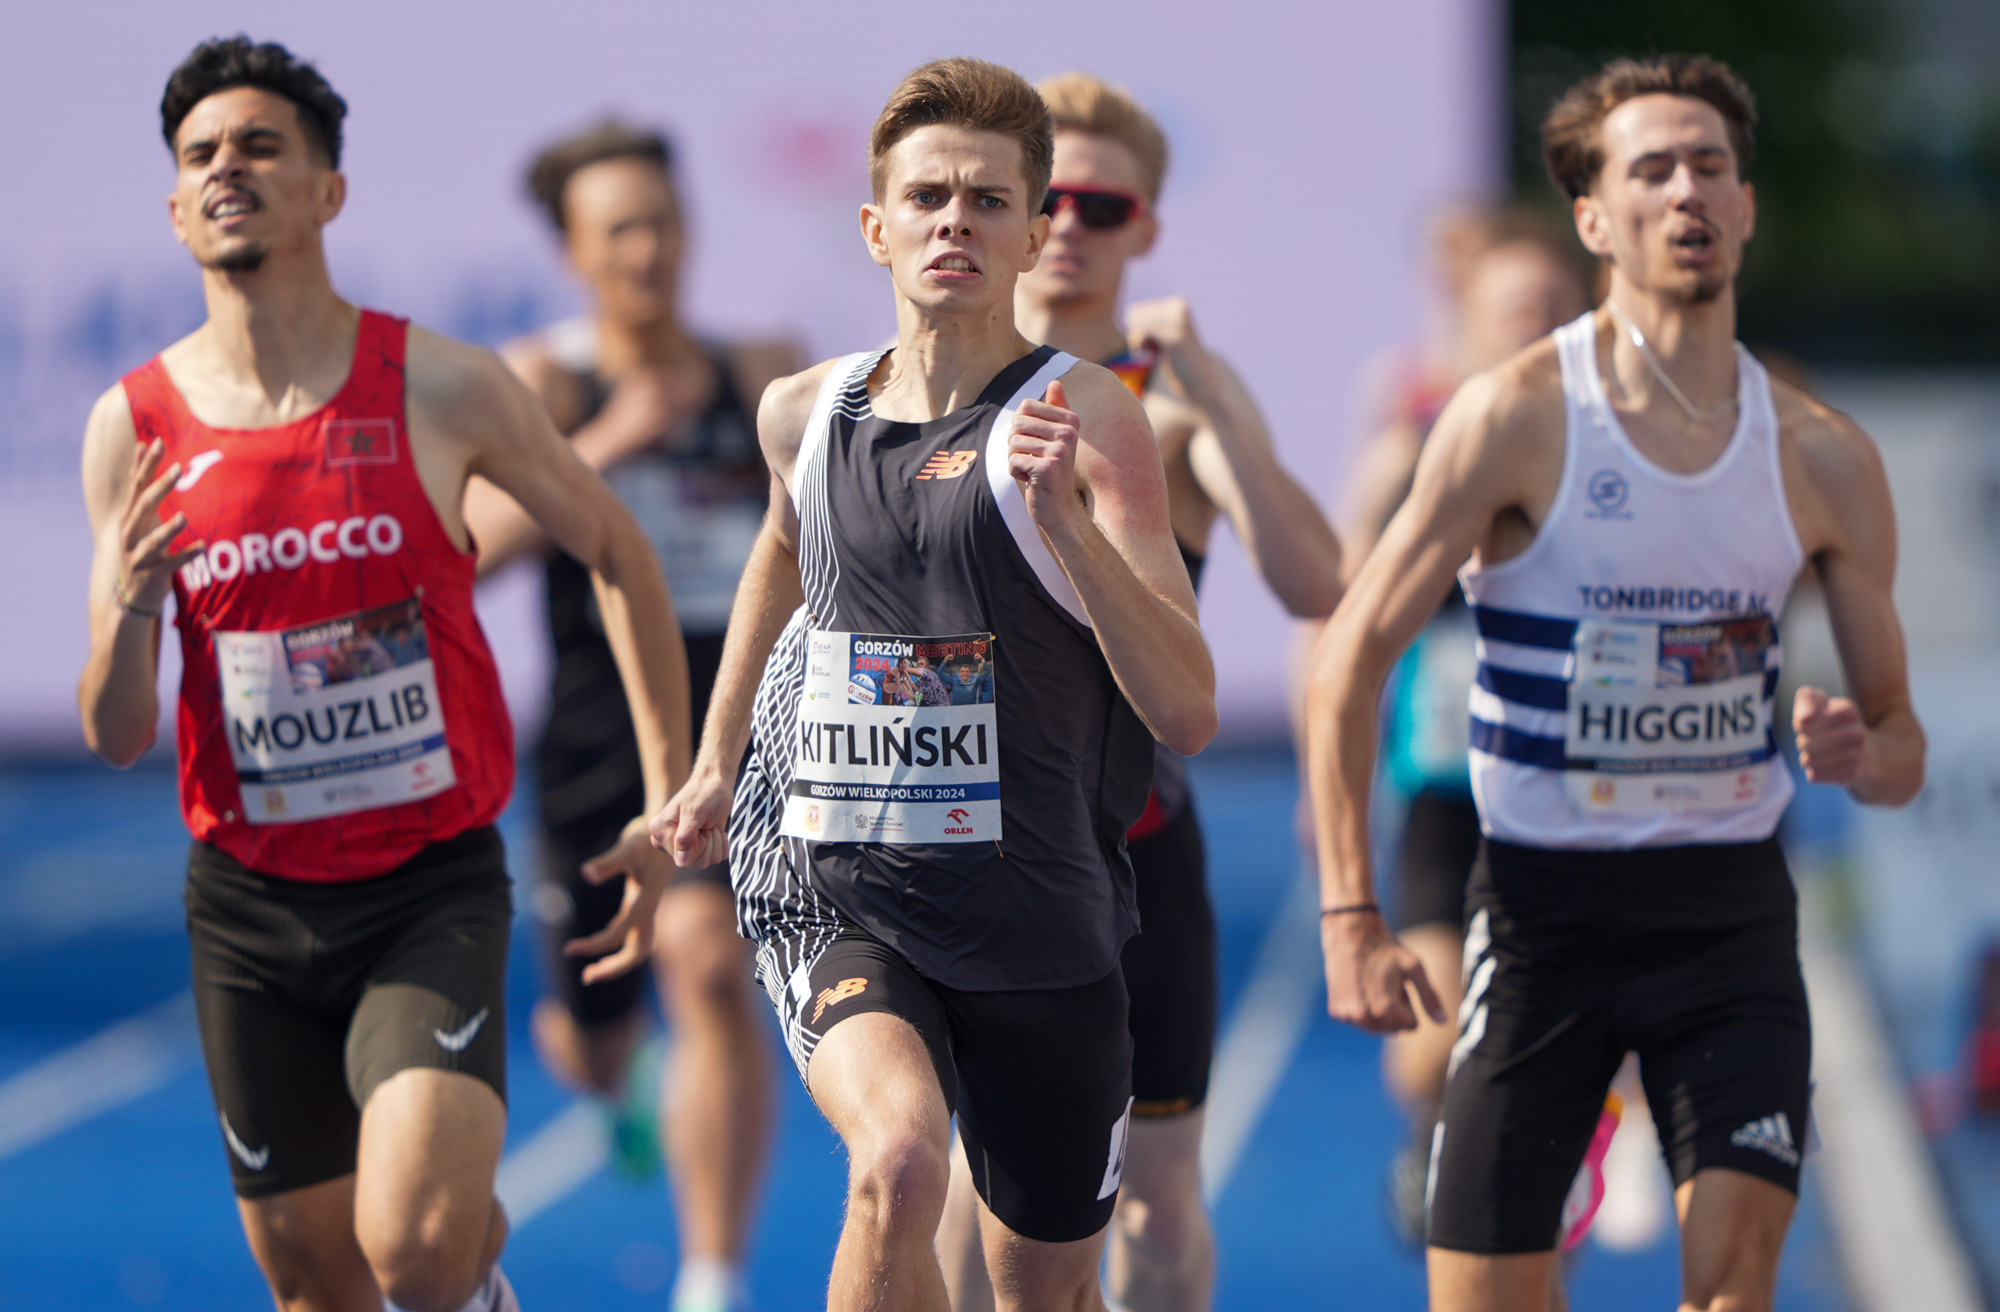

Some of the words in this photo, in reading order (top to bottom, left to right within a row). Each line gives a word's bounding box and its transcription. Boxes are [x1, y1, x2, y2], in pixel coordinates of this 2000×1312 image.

[180, 514, 403, 593] MOROCCO
[1578, 585, 1741, 612] TONBRIDGE
[854, 639, 914, 657] GORZÓW
[915, 641, 988, 658] MEETING
[854, 657, 890, 671] 2024
[234, 683, 430, 755] MOUZLIB
[1579, 694, 1757, 742] HIGGINS
[801, 716, 988, 768] KITLIŃSKI
[810, 784, 847, 797] GORZÓW
[848, 786, 933, 799] WIELKOPOLSKI
[935, 788, 966, 799] 2024
[944, 827, 974, 835] ORLEN
